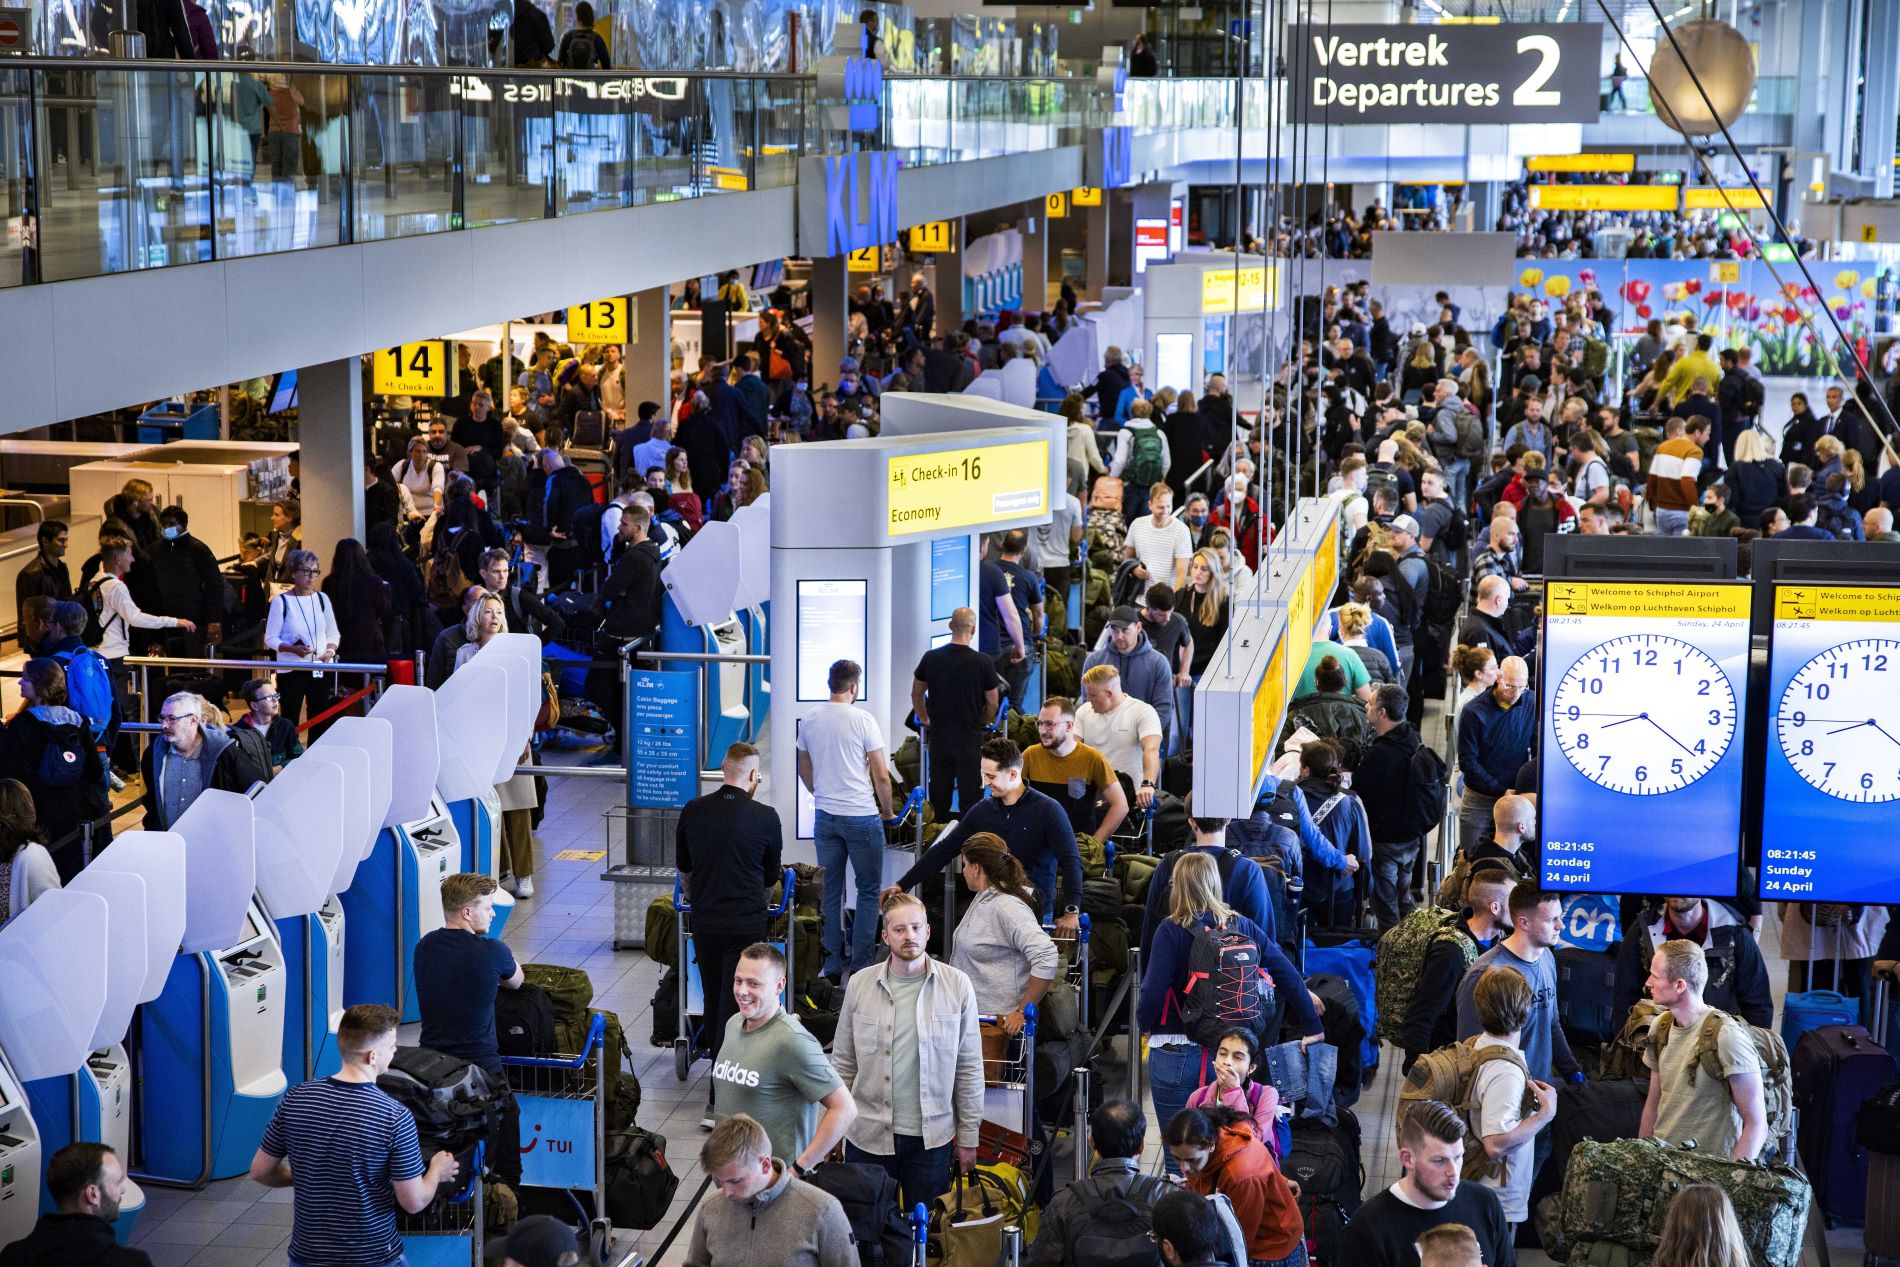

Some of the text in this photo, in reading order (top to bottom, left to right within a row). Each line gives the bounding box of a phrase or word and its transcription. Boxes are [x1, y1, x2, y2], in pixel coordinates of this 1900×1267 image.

[1313, 34, 1449, 67] Vertrek
[1512, 34, 1562, 107] 2
[1313, 76, 1500, 113] Departures
[827, 152, 898, 256] KLM
[918, 224, 940, 242] 11
[579, 301, 616, 329] 13
[387, 345, 433, 379] 14
[398, 382, 435, 392] Check-in
[911, 456, 982, 482] Check-in 16
[891, 506, 942, 524] Economy
[1591, 588, 1632, 597] Welcome
[1646, 588, 1685, 598] Schiphol
[1687, 589, 1720, 599] Airport
[1820, 592, 1863, 600] Welcome
[1590, 602, 1736, 614] Welkom op Luchthaven Schiphol
[1819, 607, 1857, 615] Welkom
[1859, 609, 1872, 617] op
[1549, 617, 1583, 625] 08:21:45
[1723, 621, 1745, 629] April
[1600, 657, 1620, 673] 11
[1633, 650, 1658, 666] 12
[1861, 654, 1888, 671] 12
[1673, 659, 1682, 675] 1
[1827, 662, 1849, 679] 11
[1578, 678, 1603, 694] 10
[1697, 680, 1710, 695] 2
[1804, 683, 1830, 700] 10
[653, 697, 678, 705] Baggage
[1568, 705, 1580, 721] 9
[1708, 709, 1721, 725] 3
[1792, 711, 1806, 727] 9
[1576, 733, 1589, 749] 8
[1693, 739, 1706, 755] 4
[1800, 739, 1814, 756] 8
[1598, 755, 1611, 771] 7
[1670, 758, 1683, 774] 5
[1823, 762, 1836, 778] 7
[1635, 766, 1648, 782] 6
[1860, 772, 1873, 789] 6
[1547, 841, 1595, 852] 08:21:45
[1767, 849, 1816, 860] 08:21:45
[1546, 857, 1591, 870] zondag
[1766, 864, 1813, 878] Sunday
[1546, 872, 1591, 884] 24 april
[1765, 880, 1813, 893] 24 April
[545, 1140, 573, 1153] TUI
